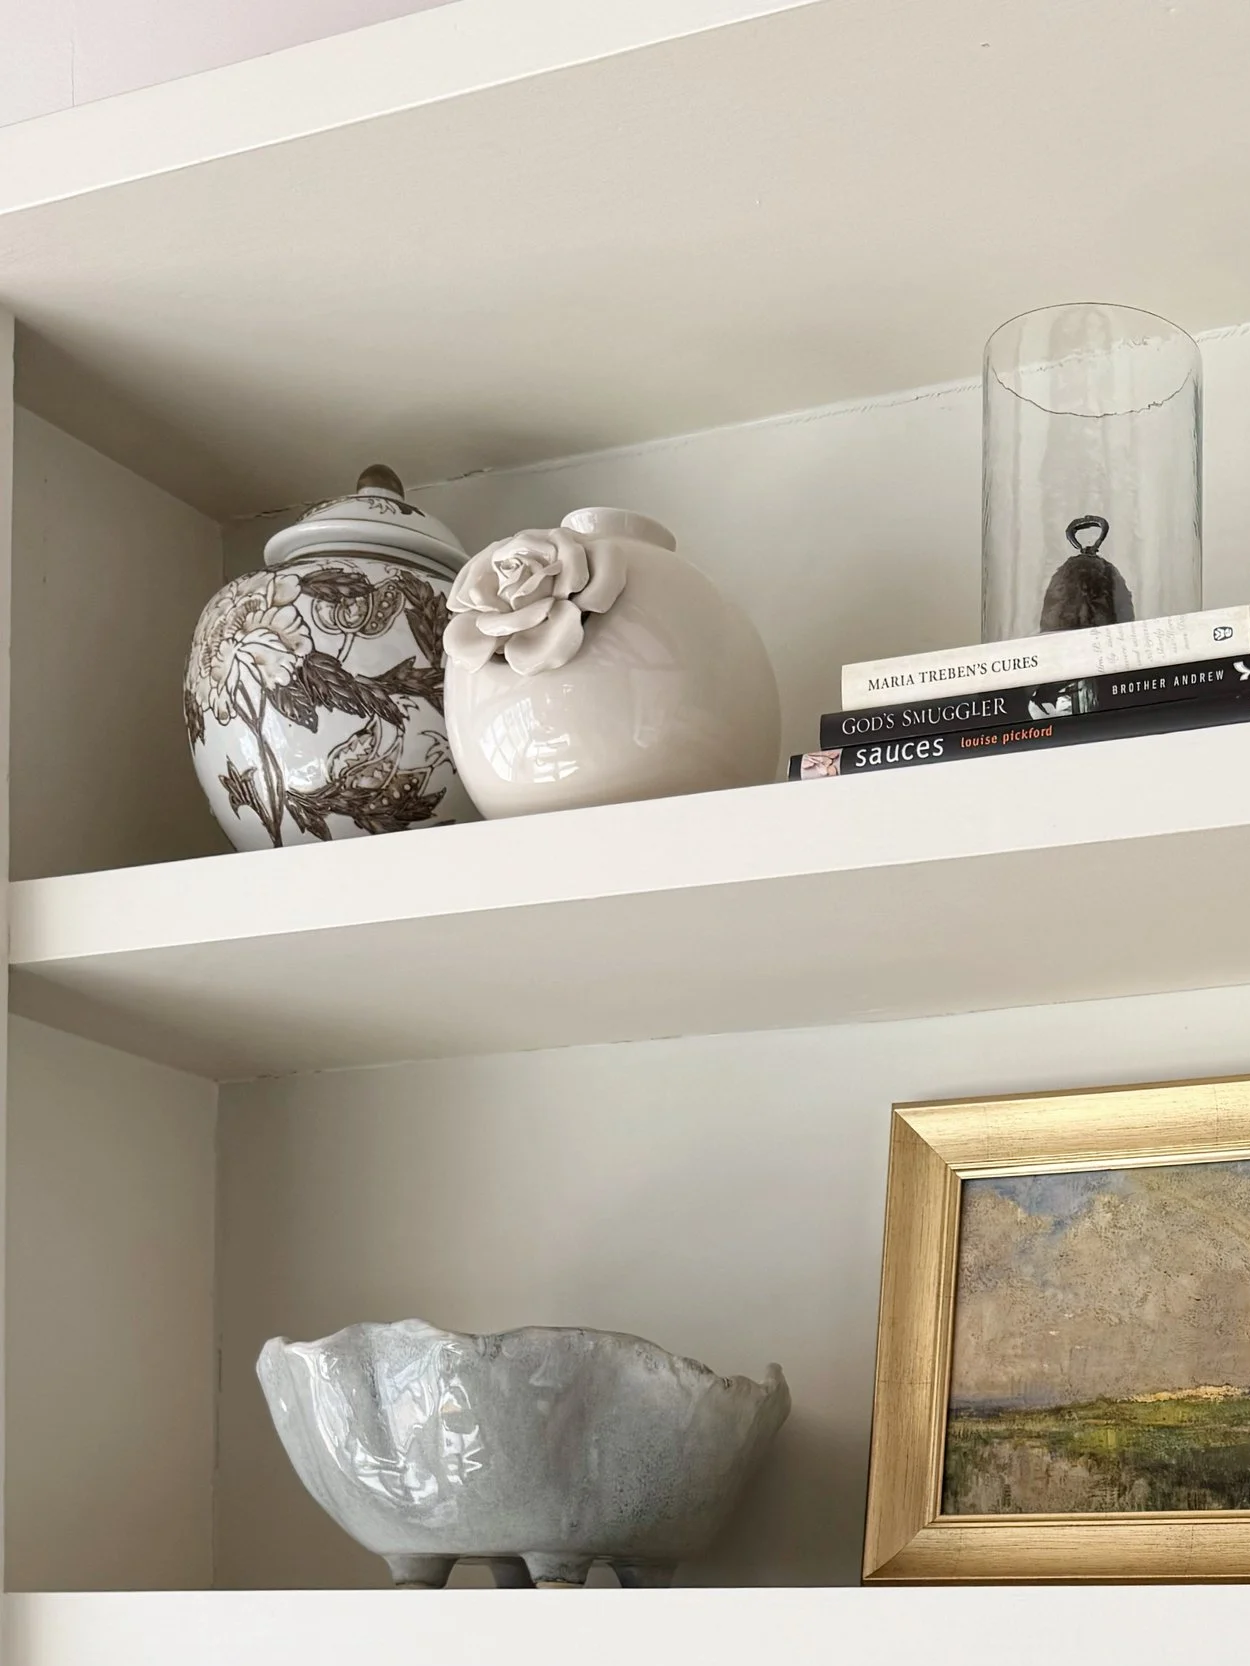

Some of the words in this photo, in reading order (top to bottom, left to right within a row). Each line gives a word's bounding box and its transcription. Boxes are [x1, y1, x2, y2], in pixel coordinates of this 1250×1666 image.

[868, 673, 915, 692] MARIA
[919, 663, 988, 684] TREBEN'S
[991, 655, 1038, 674] CURES
[1112, 678, 1166, 695] BROTHER
[1173, 670, 1225, 687] ANDREW
[842, 712, 896, 735] GOD'S
[902, 697, 1008, 728] SMUGGLER
[961, 732, 998, 748] louise
[1002, 725, 1053, 745] pickford
[855, 738, 945, 768] sauces
